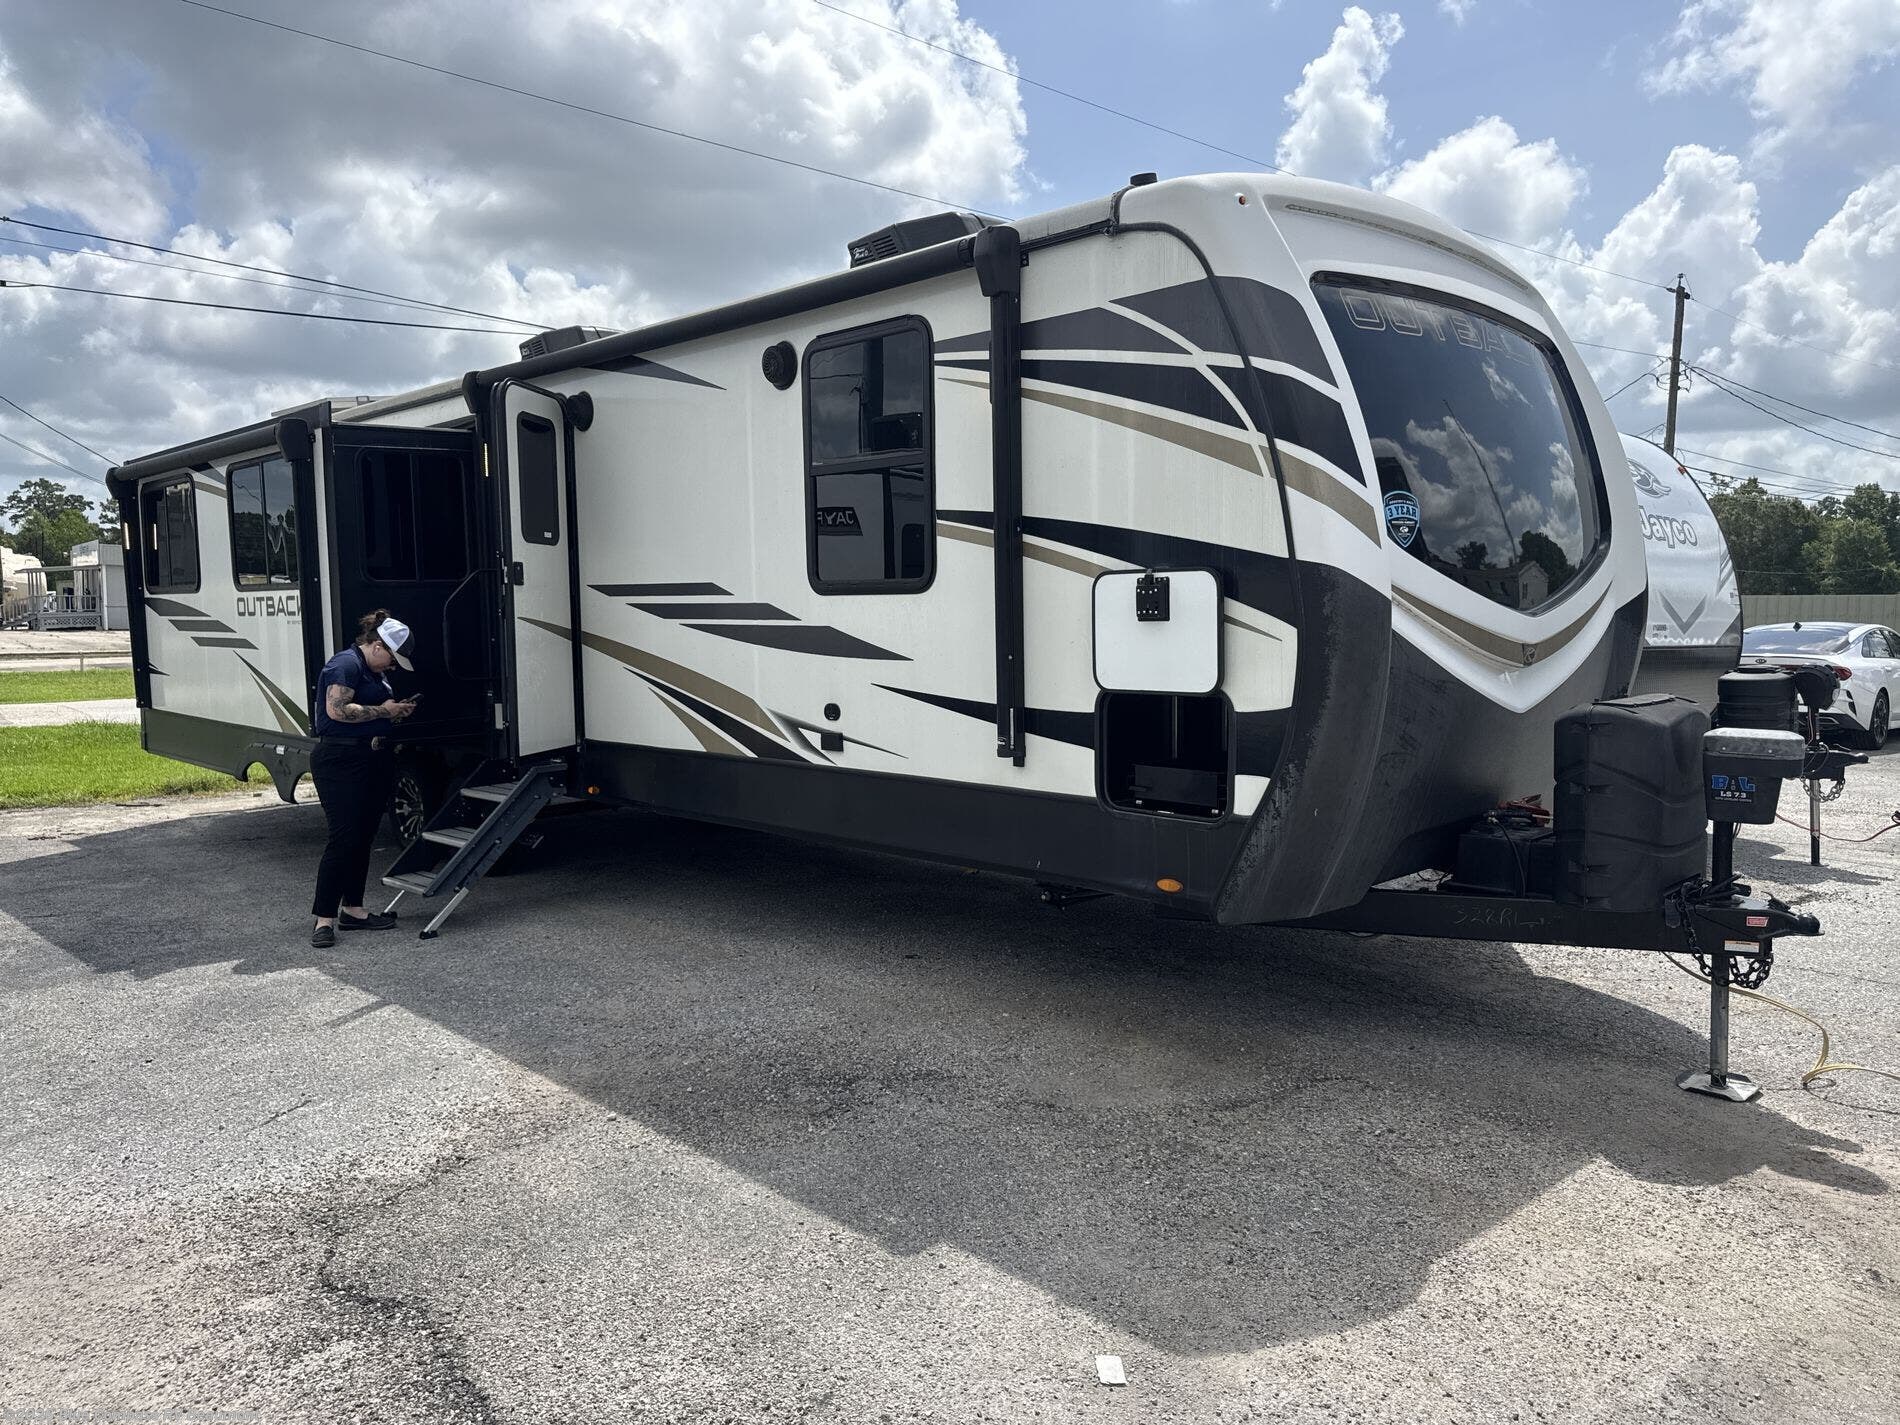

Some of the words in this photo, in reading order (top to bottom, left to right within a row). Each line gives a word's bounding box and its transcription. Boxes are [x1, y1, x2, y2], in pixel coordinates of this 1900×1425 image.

[1387, 507, 1394, 517] 3
[1394, 505, 1417, 517] YEAR
[1639, 505, 1698, 549] Jayco
